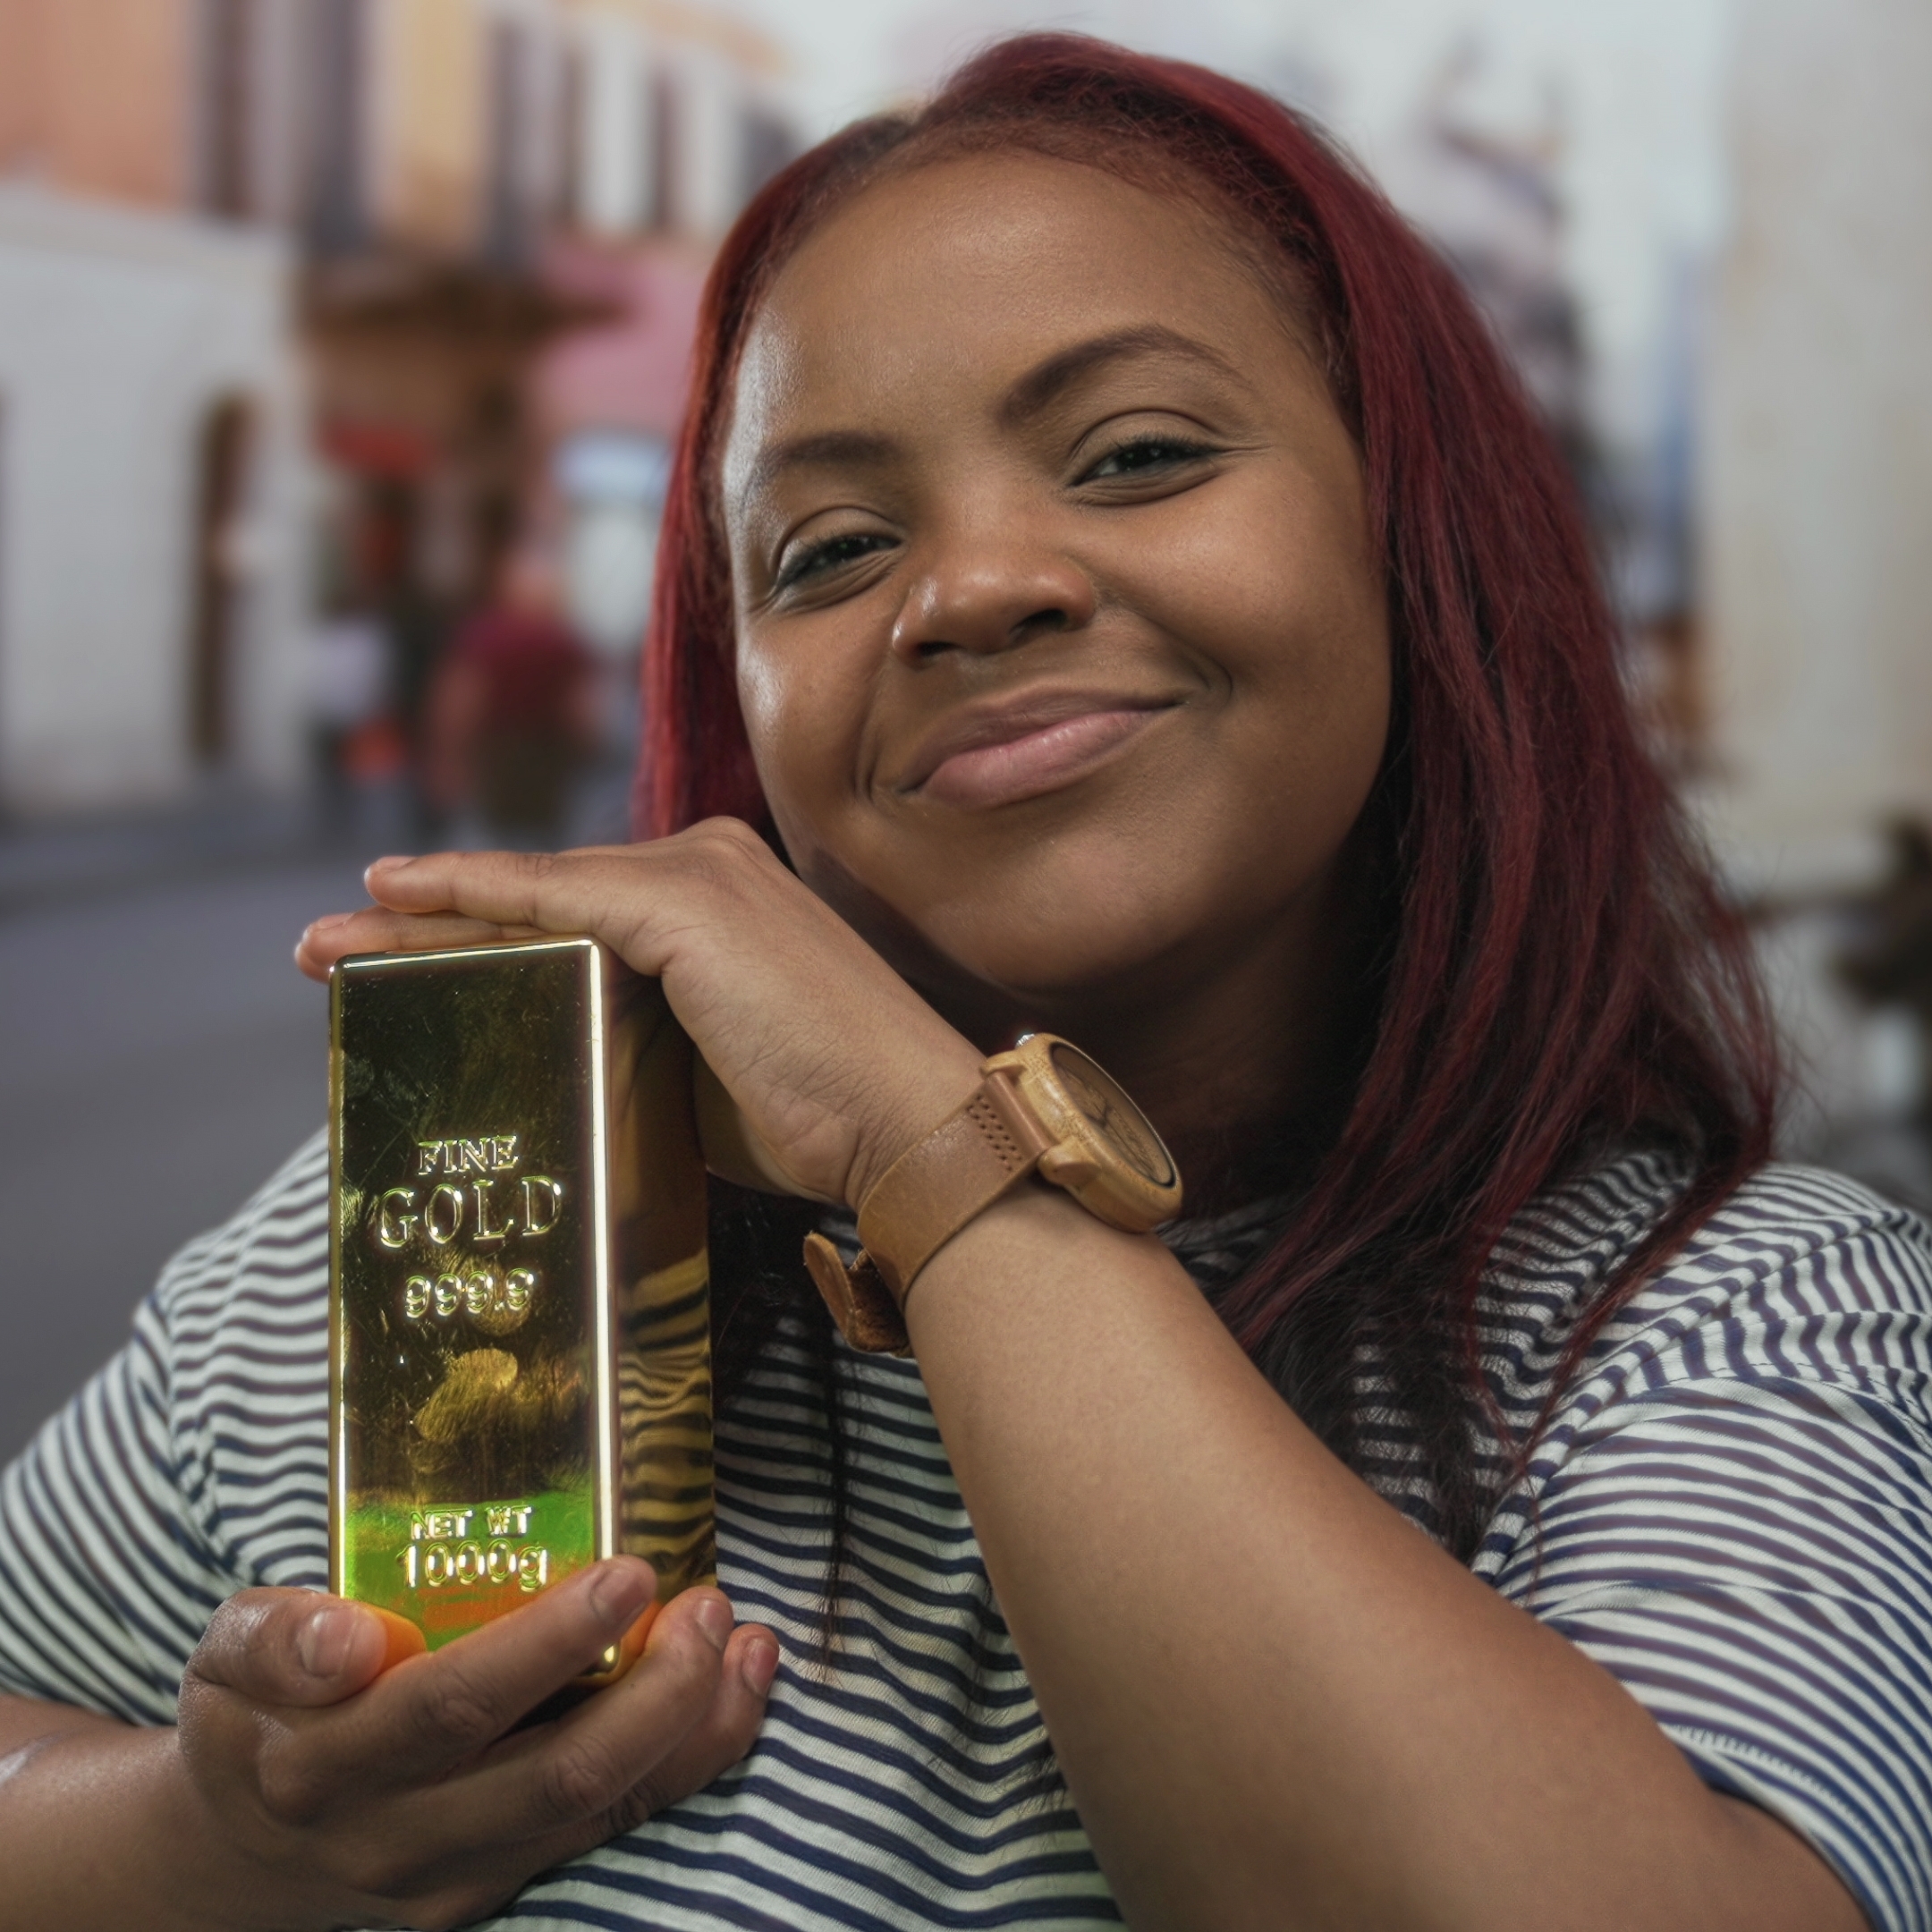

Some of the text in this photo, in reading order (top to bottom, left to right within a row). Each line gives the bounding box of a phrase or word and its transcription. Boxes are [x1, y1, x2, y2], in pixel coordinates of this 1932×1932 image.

[418, 1135, 519, 1175] FINE
[380, 1175, 562, 1248] GOLD
[405, 1267, 534, 1318] 999.9
[411, 1504, 532, 1540] NET WT
[395, 1538, 547, 1592] 1000g
